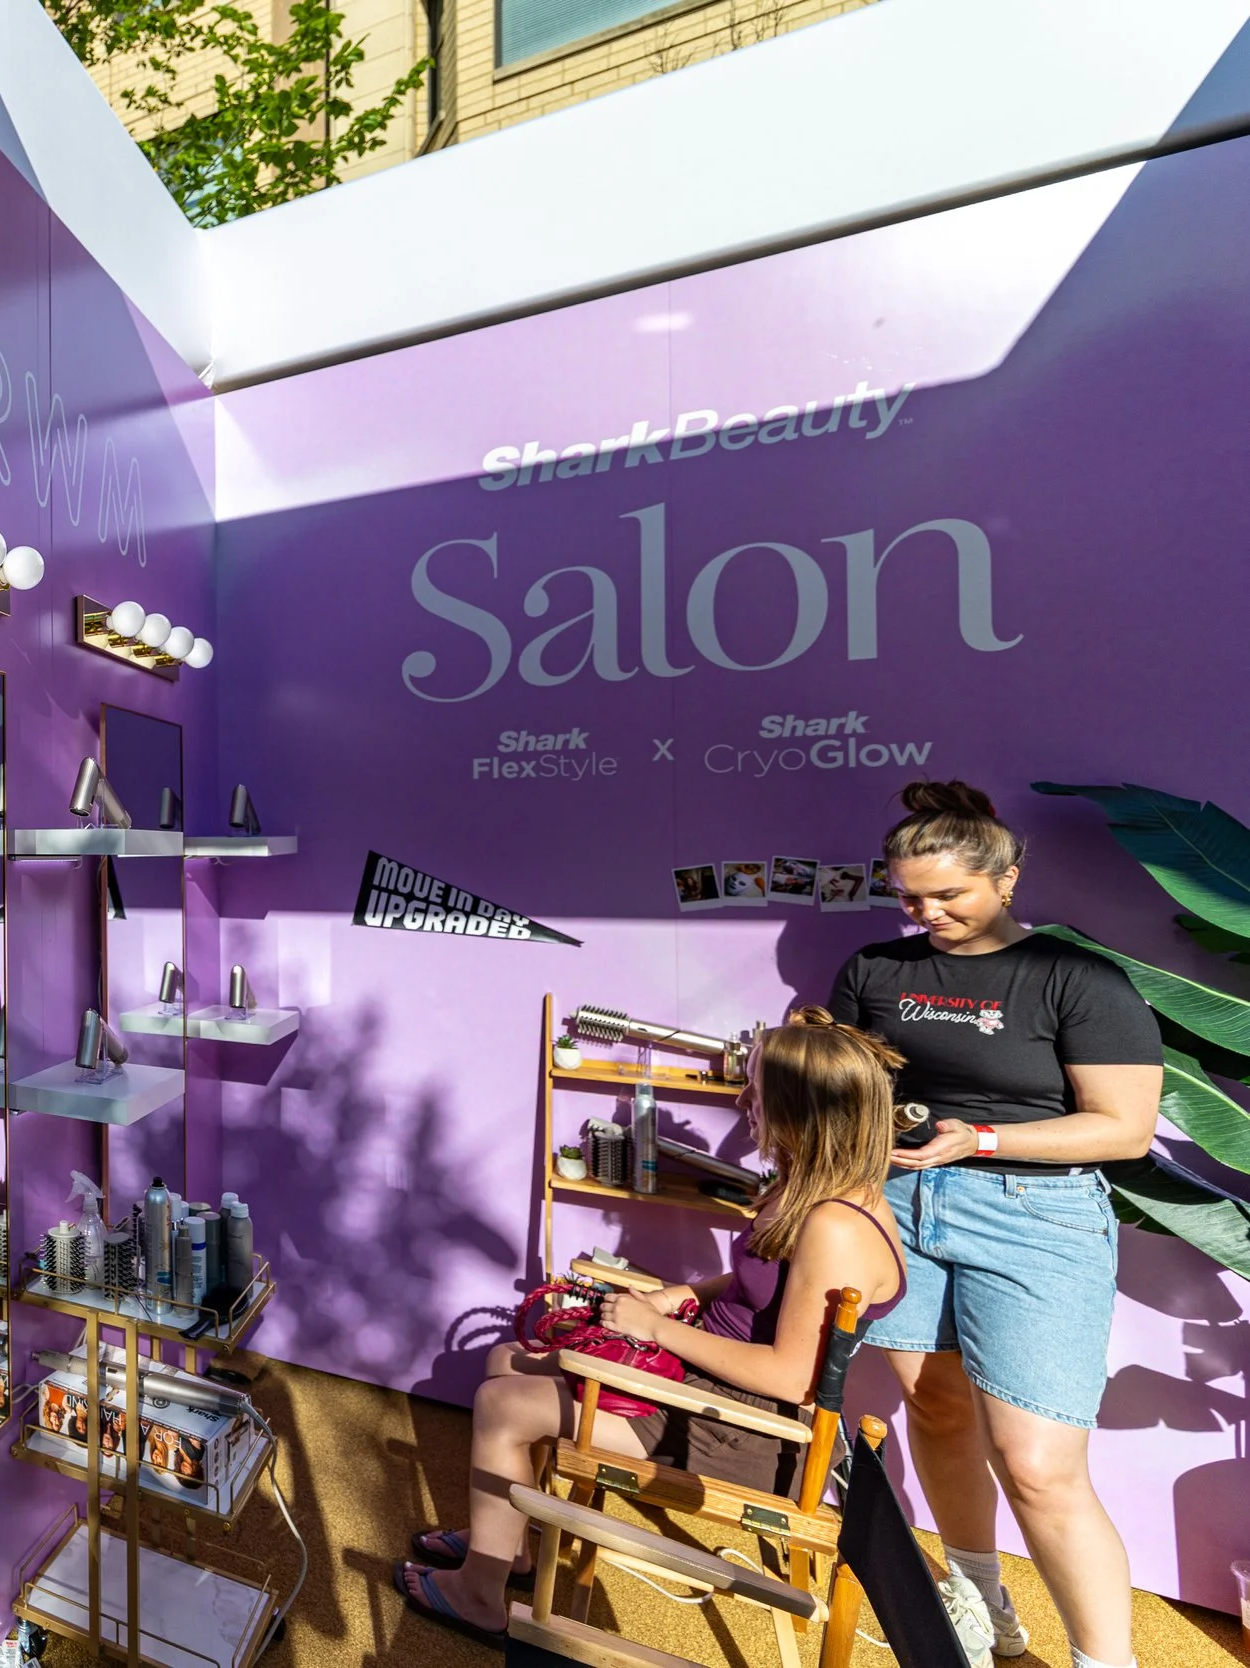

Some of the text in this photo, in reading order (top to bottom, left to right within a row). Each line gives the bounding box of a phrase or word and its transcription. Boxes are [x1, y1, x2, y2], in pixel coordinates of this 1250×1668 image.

[478, 381, 917, 491] SharkBeauty
[401, 502, 1024, 702] Salon
[758, 710, 870, 739] Shark
[497, 728, 590, 753] Shark
[472, 751, 618, 781] FlexStyle
[704, 737, 934, 778] CryoGlow
[373, 856, 530, 926] MOVE IN DAY
[364, 888, 532, 940] UPGRADED
[899, 998, 981, 1026] Wisconsin
[980, 1000, 1002, 1010] OF
[186, 1405, 220, 1422] Shark
[154, 1427, 182, 1449] FOR
